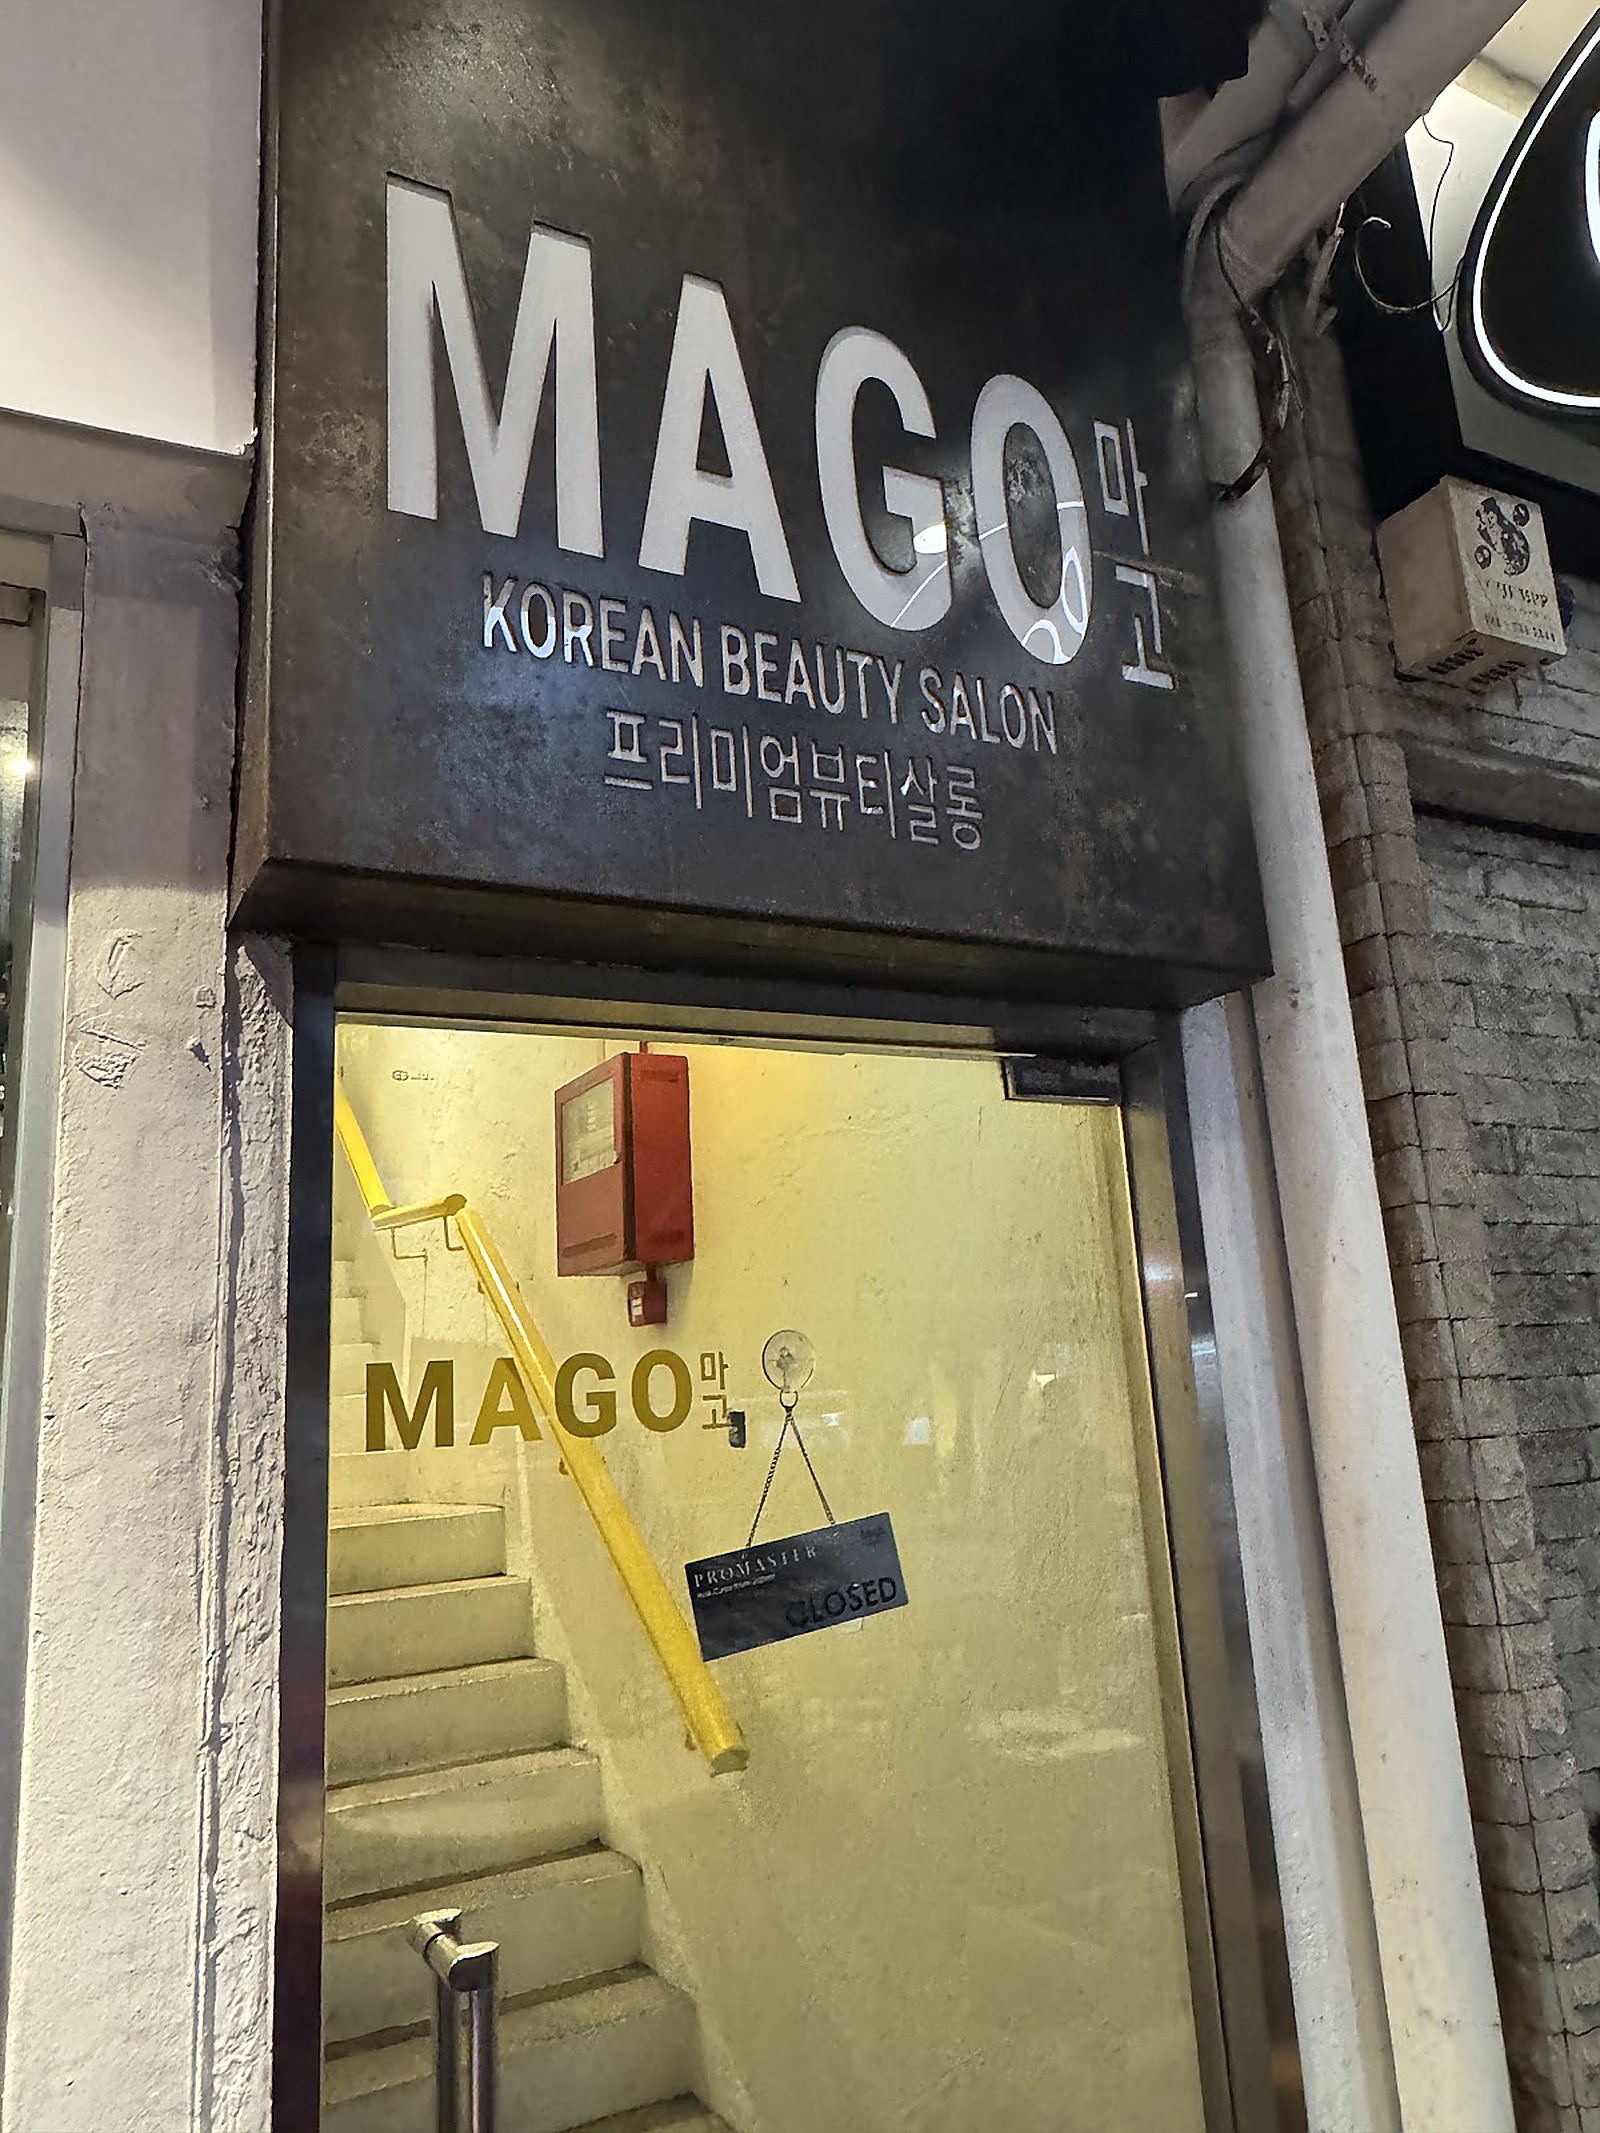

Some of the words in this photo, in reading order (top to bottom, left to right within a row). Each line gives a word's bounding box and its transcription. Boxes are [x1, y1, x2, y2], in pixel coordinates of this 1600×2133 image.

[386, 172, 1091, 664] MAGO
[1093, 417, 1176, 690] 마고
[483, 571, 703, 688] KOREAN
[721, 625, 904, 724] BEAUTY
[919, 667, 1058, 754] SALON
[366, 1349, 692, 1452] MAGO
[700, 1351, 731, 1429] 마고
[785, 1576, 897, 1629] CLOSED
